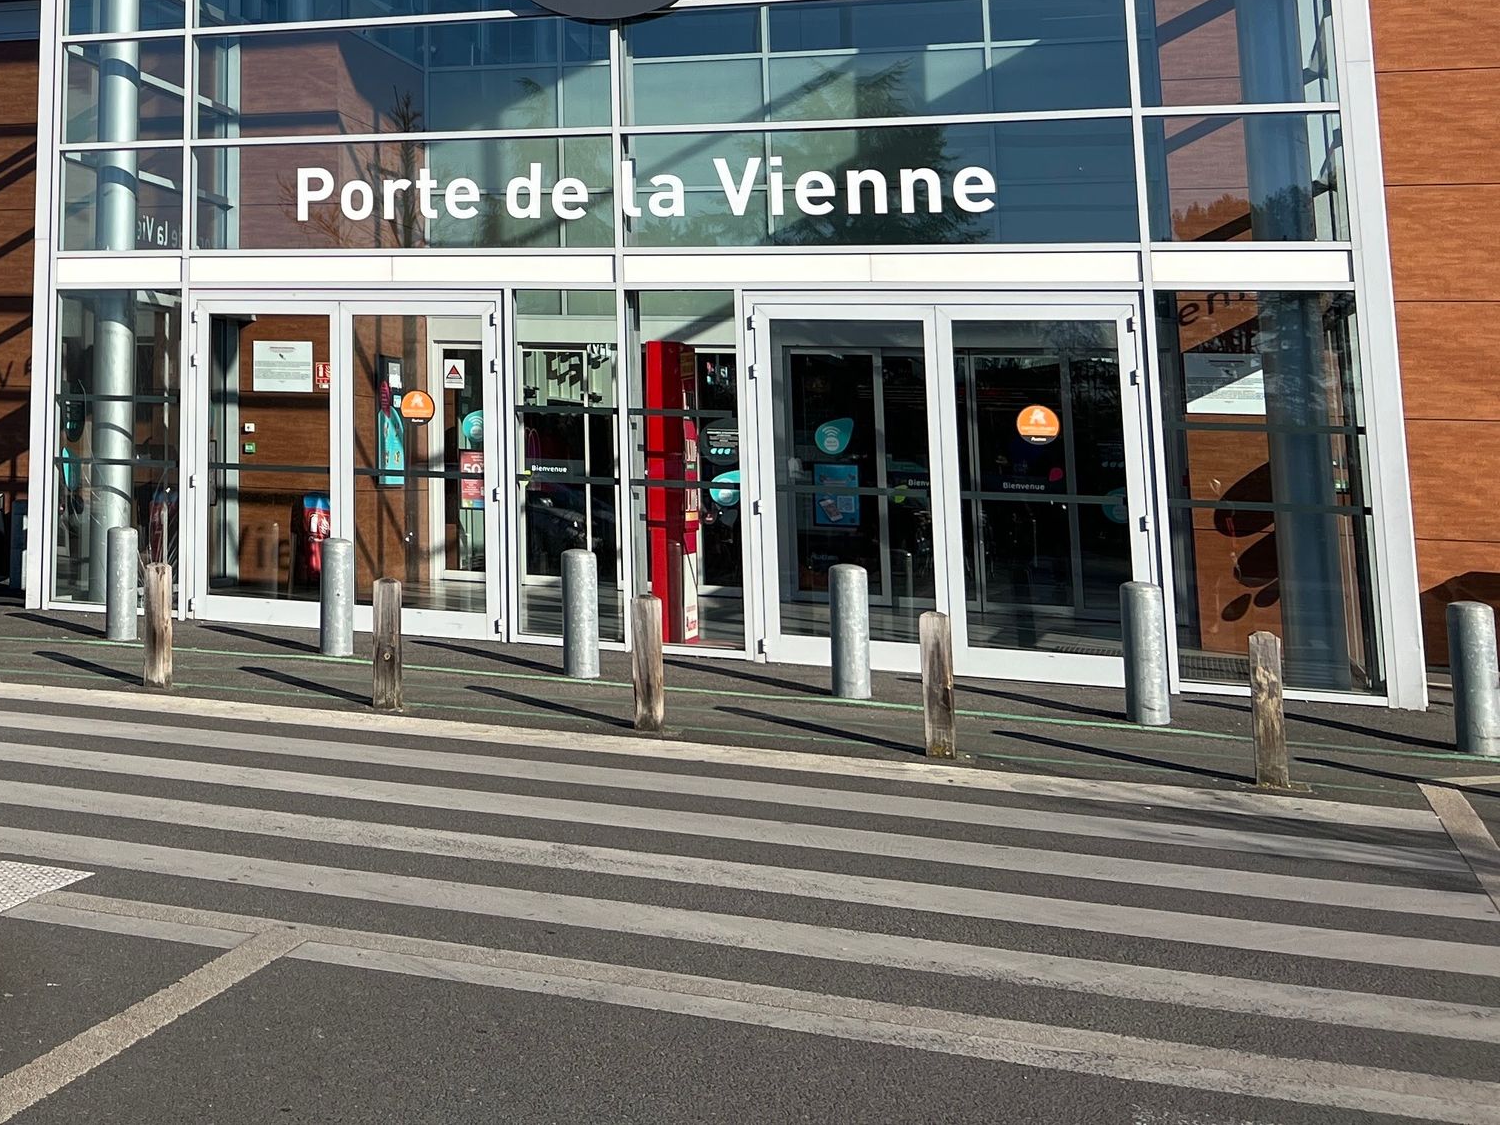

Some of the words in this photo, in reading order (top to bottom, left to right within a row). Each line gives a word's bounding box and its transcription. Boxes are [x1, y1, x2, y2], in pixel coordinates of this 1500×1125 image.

[296, 166, 480, 222] Porte
[506, 162, 589, 219] de
[622, 160, 686, 217] la
[712, 156, 997, 217] Vienne
[531, 464, 568, 473] Bienvenue
[1002, 481, 1046, 491] Bienvenue
